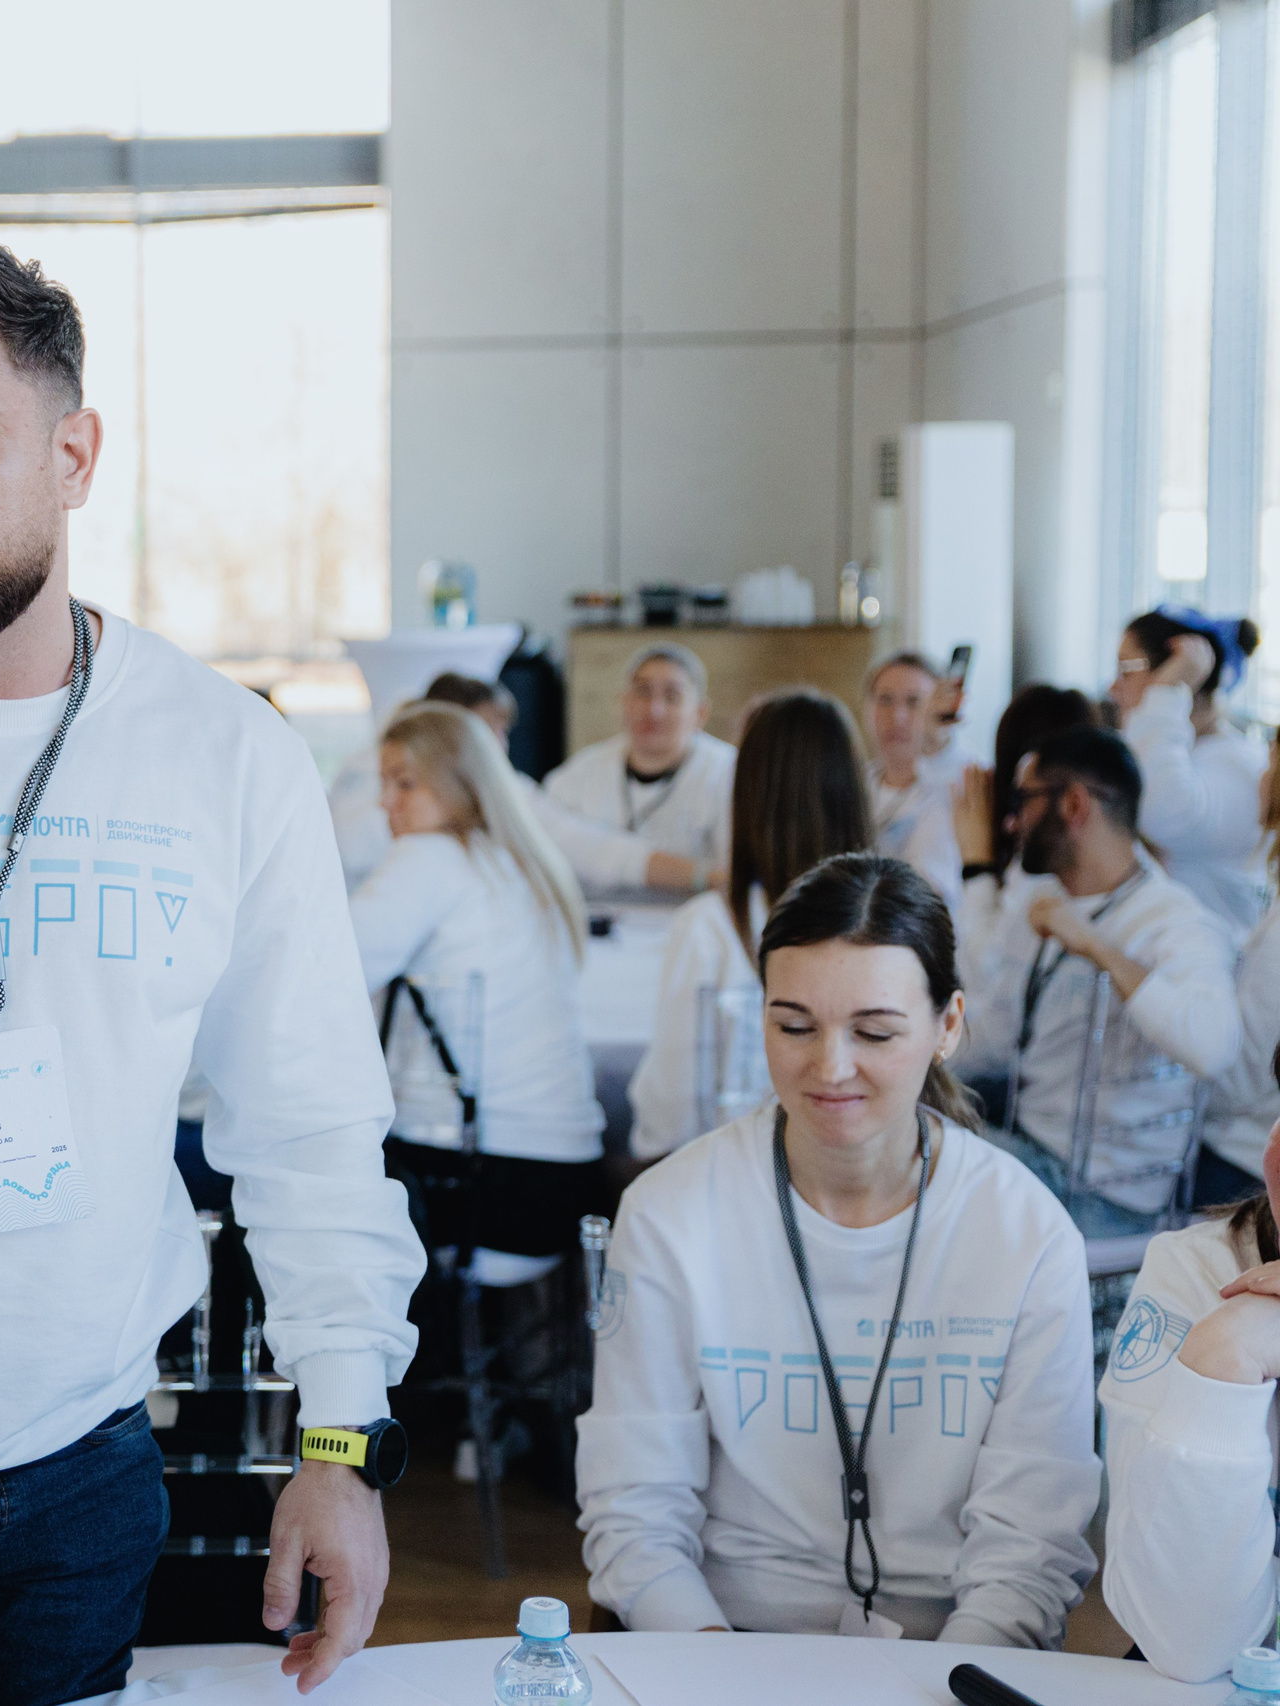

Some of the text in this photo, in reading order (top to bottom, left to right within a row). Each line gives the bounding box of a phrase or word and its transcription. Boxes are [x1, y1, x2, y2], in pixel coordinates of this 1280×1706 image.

[106, 819, 192, 842] ВОЛОНТЁРСКОЕ
[106, 830, 173, 848] ДВИЖЕНИЕ
[3, 1136, 14, 1144] АО
[51, 1144, 68, 1154] 2025
[2, 1178, 49, 1202] ДОБРОГО
[44, 1160, 71, 1190] СЕРДЦА
